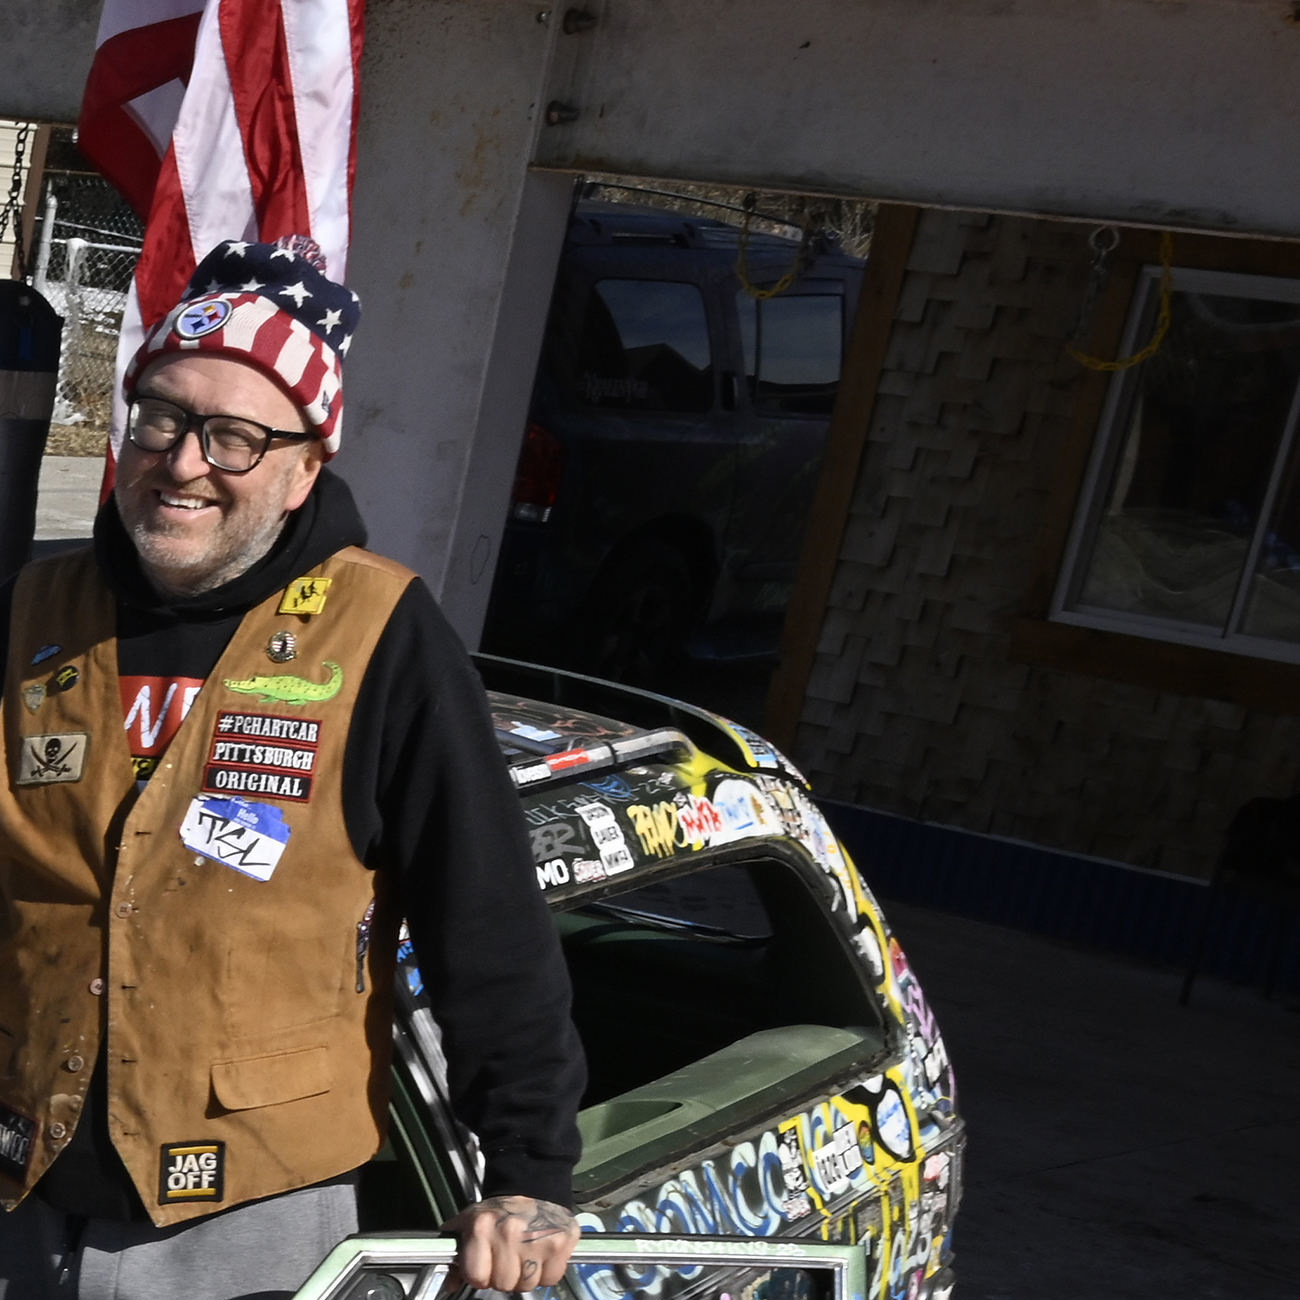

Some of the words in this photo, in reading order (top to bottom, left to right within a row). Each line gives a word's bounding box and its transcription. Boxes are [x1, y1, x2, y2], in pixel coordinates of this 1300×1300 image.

[218, 714, 318, 742] #PGHARTCAR
[212, 742, 314, 770] PITTSBURGH
[215, 770, 303, 796] ORIGINAL
[168, 1152, 217, 1173] JAG
[167, 1171, 216, 1190] OFF
